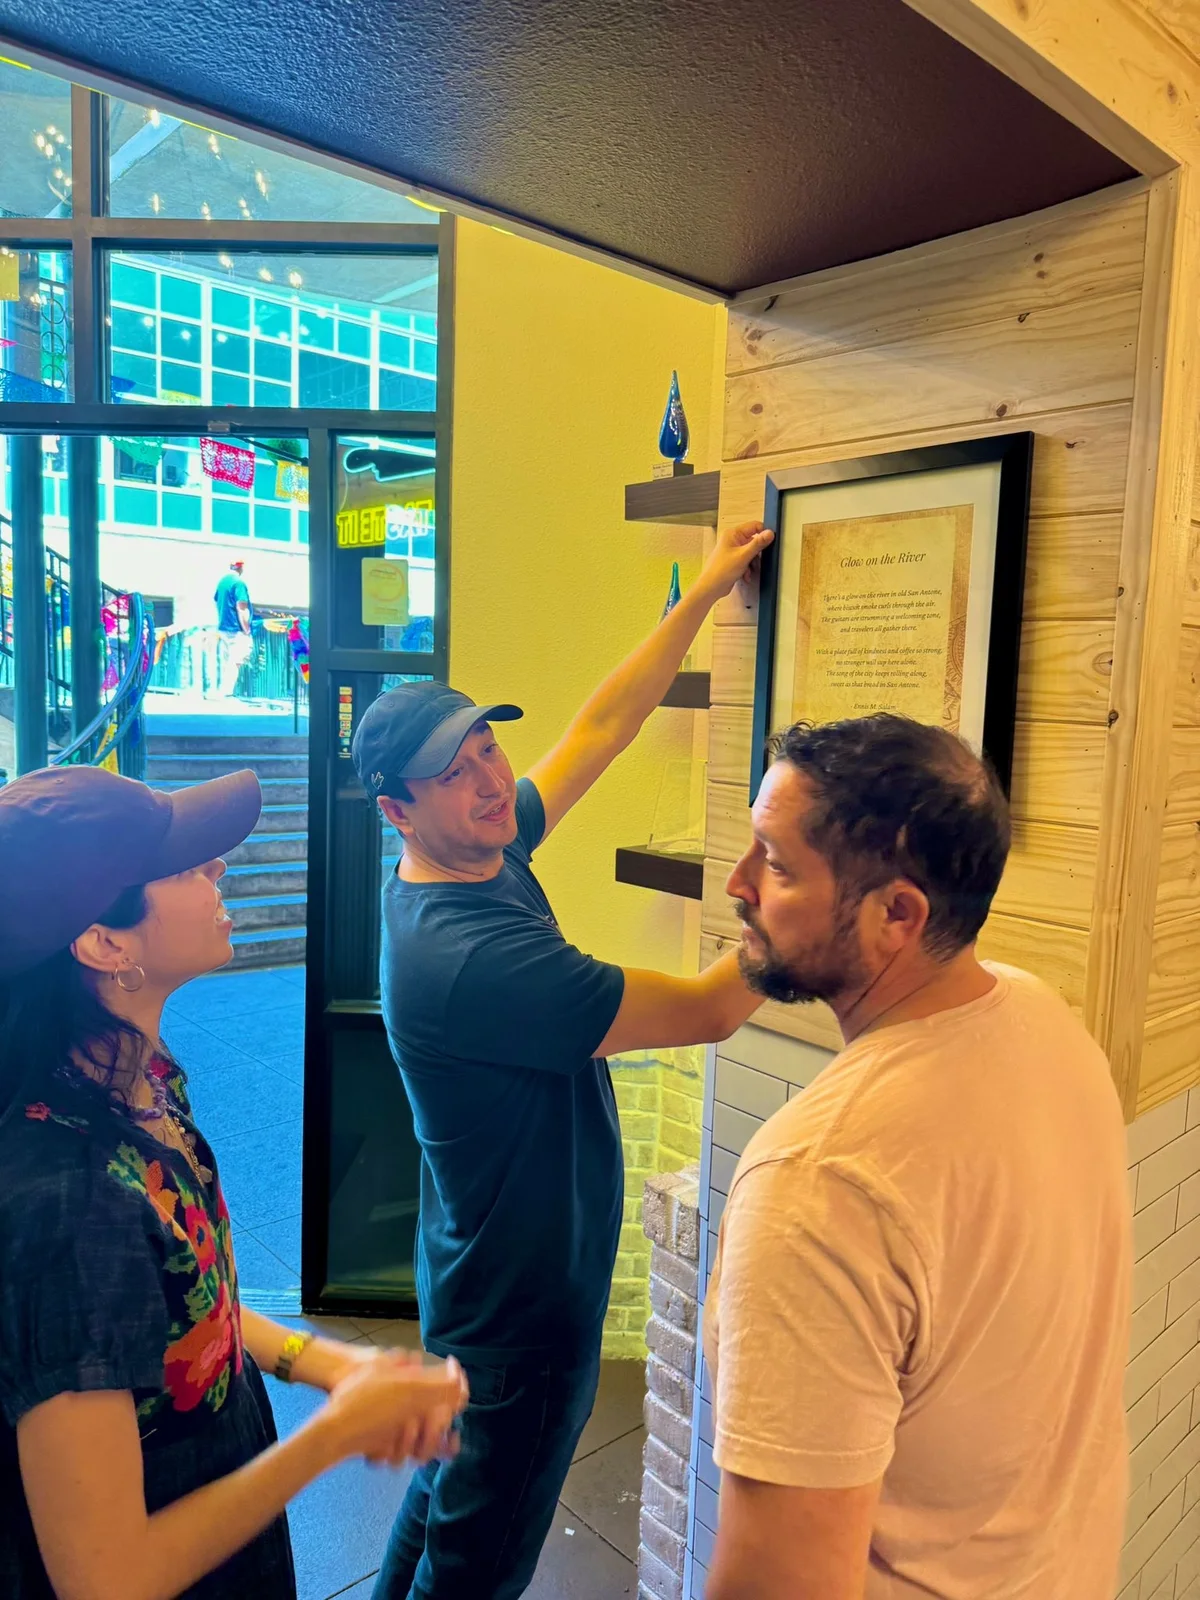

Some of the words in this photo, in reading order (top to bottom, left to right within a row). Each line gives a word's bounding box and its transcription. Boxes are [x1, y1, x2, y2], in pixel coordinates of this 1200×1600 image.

[840, 556, 864, 568] Glow
[865, 557, 878, 566] on
[880, 553, 896, 565] the
[898, 551, 926, 563] River
[845, 593, 858, 601] glow
[892, 601, 914, 609] through
[830, 616, 850, 624] guitars
[882, 625, 901, 633] gather
[833, 648, 847, 656] plate
[846, 648, 858, 656] full
[857, 648, 864, 656] of
[899, 647, 916, 655] coffee
[848, 670, 855, 678] of
[864, 670, 874, 678] city
[875, 670, 890, 678] keeps
[890, 670, 910, 678] rolling
